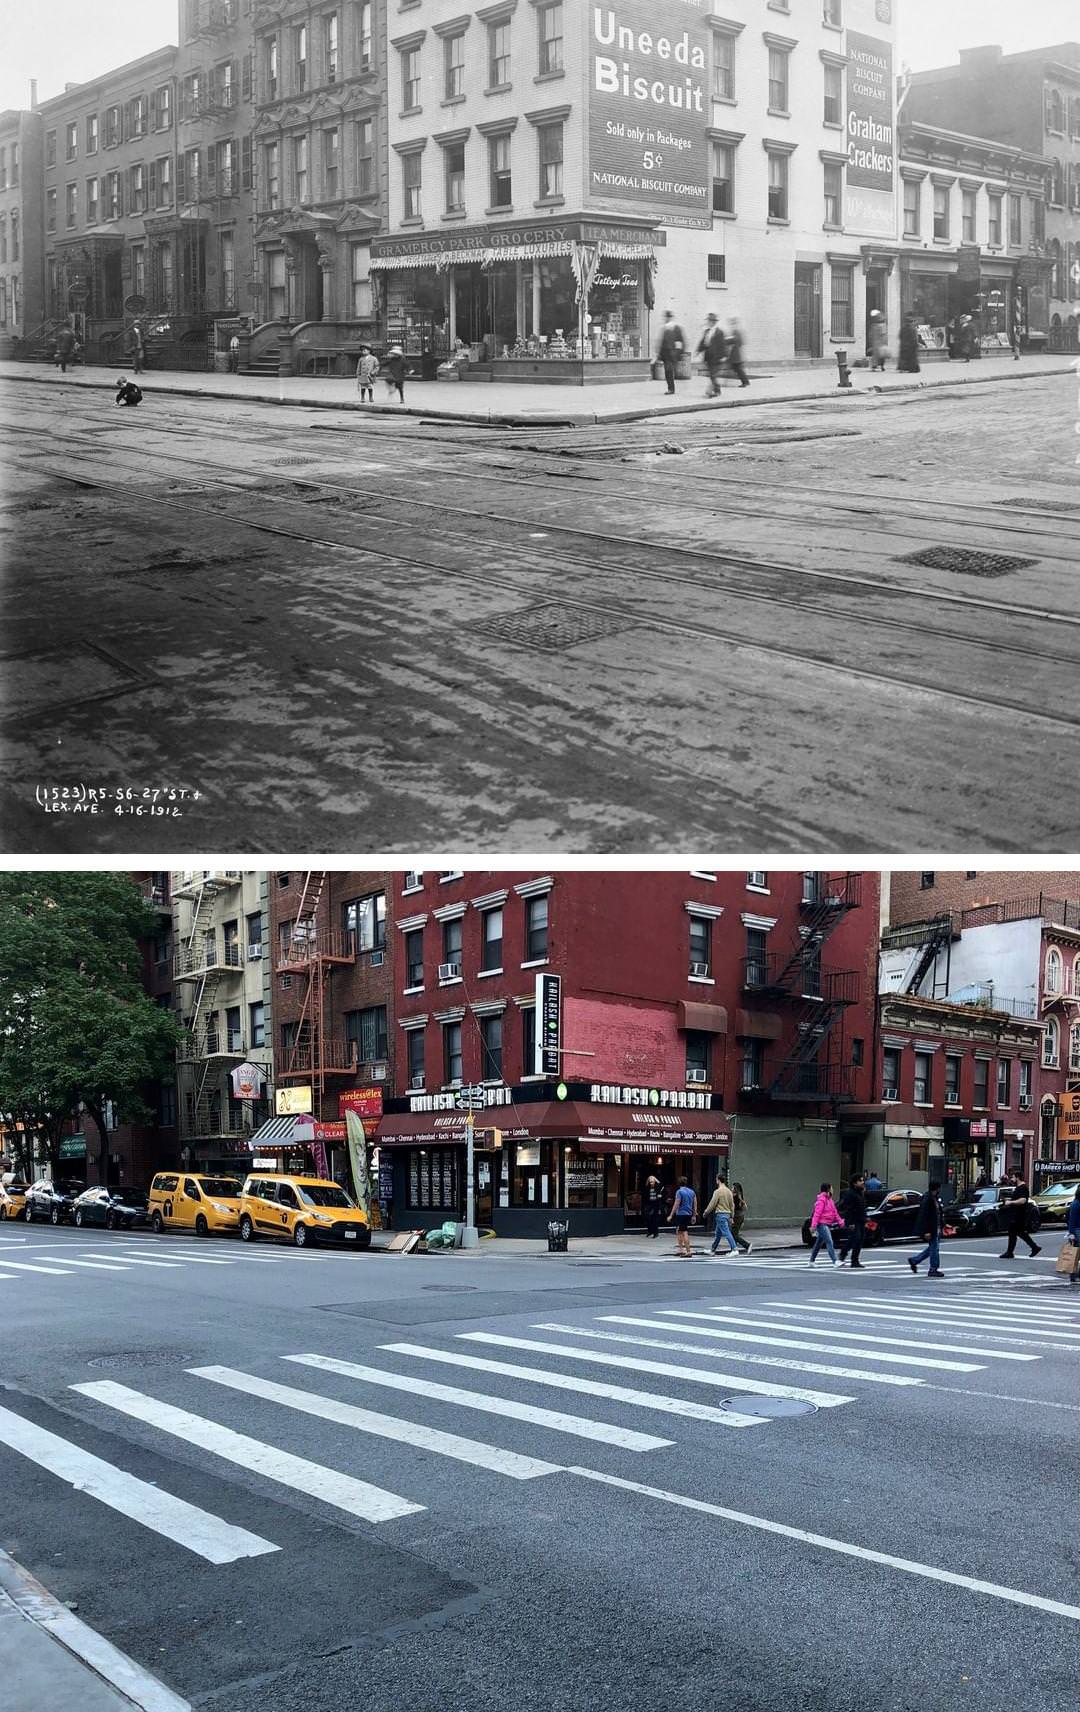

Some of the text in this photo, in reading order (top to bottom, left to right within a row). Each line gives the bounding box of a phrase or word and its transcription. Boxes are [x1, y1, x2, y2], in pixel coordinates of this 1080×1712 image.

[594, 7, 705, 69] Uneeda
[850, 49, 887, 69] NATIONAL
[595, 56, 703, 112] Biscuit
[855, 67, 882, 83] BISCUIT
[853, 83, 887, 100] COMPANY
[606, 121, 691, 150] Sold only in Packages
[848, 111, 892, 144] Graham
[642, 151, 663, 169] 5¢
[848, 142, 892, 172] Crackers
[592, 171, 707, 197] NATIONAL BISCUIT COMPANY
[379, 240, 445, 257] GRAMERCY
[449, 236, 484, 250] PARK
[489, 227, 568, 247] GROCERY
[586, 226, 610, 241] TEA
[523, 240, 572, 256] LUXURIES
[591, 1084, 712, 1110] KAILASH PARBAT
[512, 1128, 529, 1136] London
